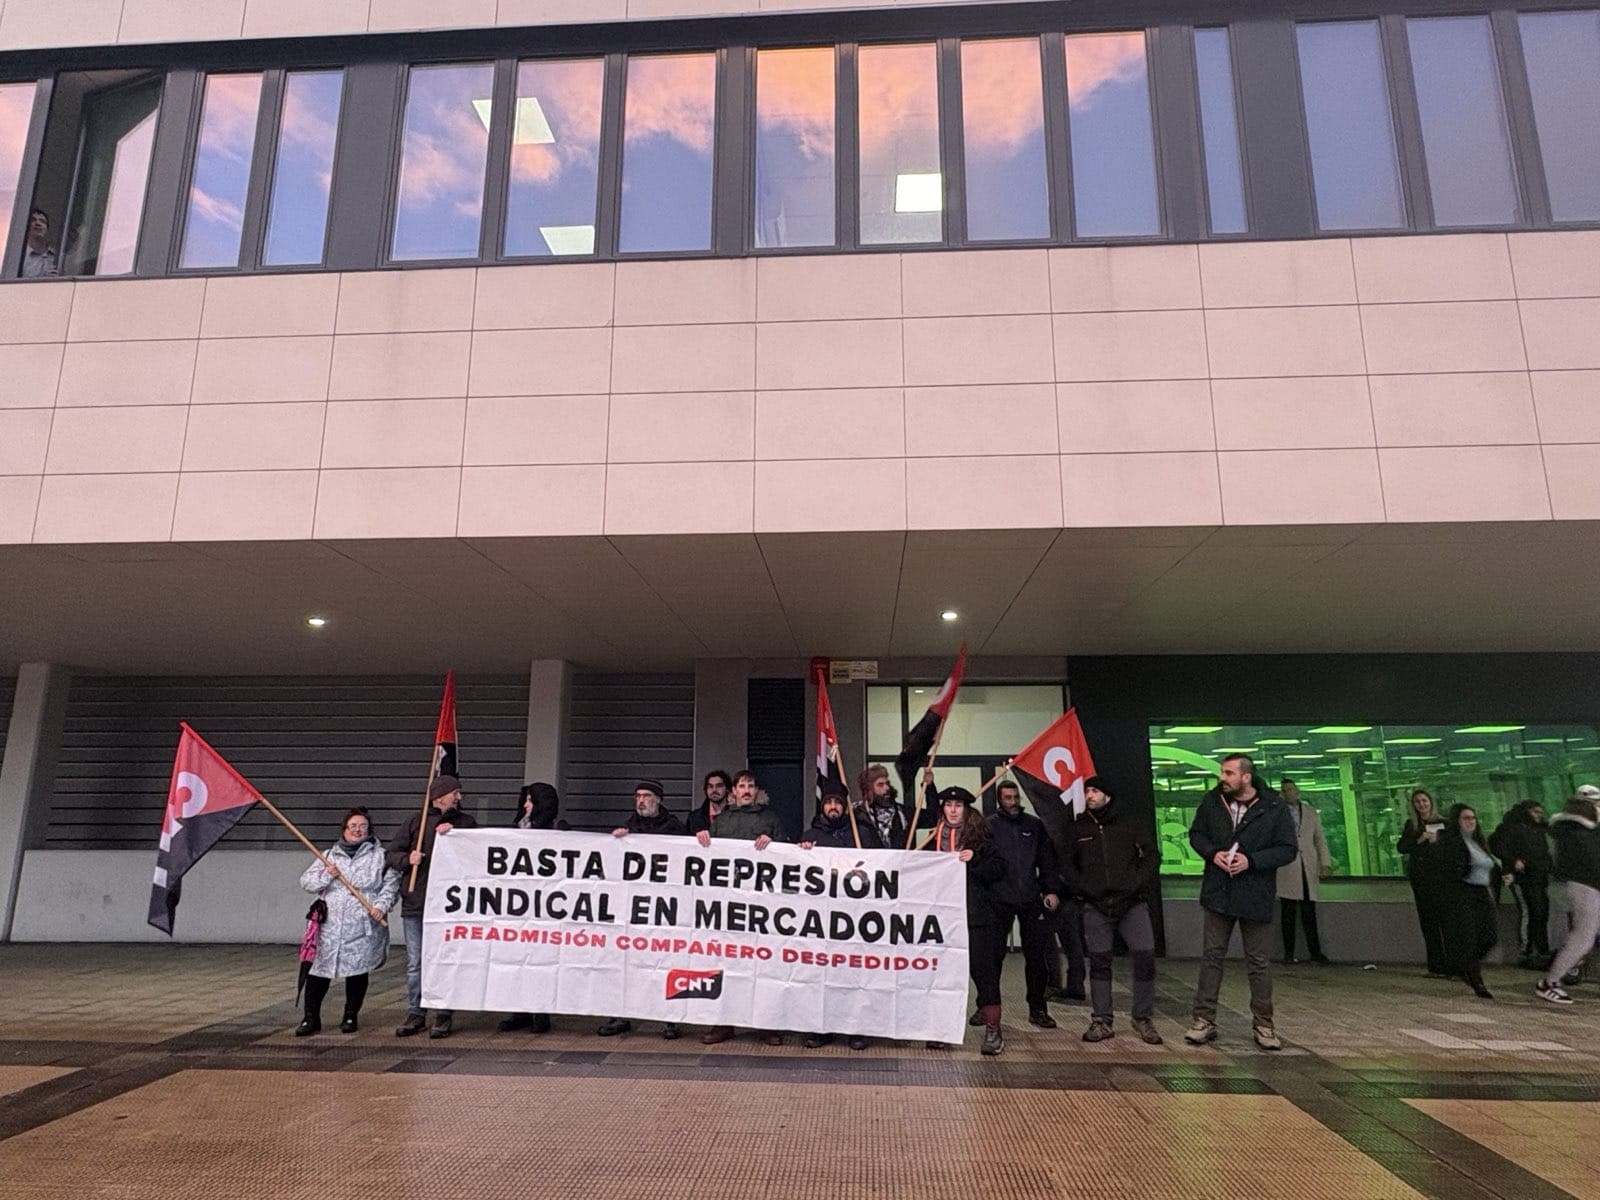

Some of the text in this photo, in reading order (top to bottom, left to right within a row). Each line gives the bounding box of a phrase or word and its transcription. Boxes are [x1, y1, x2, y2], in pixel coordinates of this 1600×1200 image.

[488, 847, 899, 899] BASTA DE REPRESIÓN
[445, 886, 944, 944] SINDICAL EN MERCADONA
[444, 926, 938, 971] ¡READMISIÓN COMPAÑERO DESPEDIDO!
[674, 976, 715, 992] CNT
